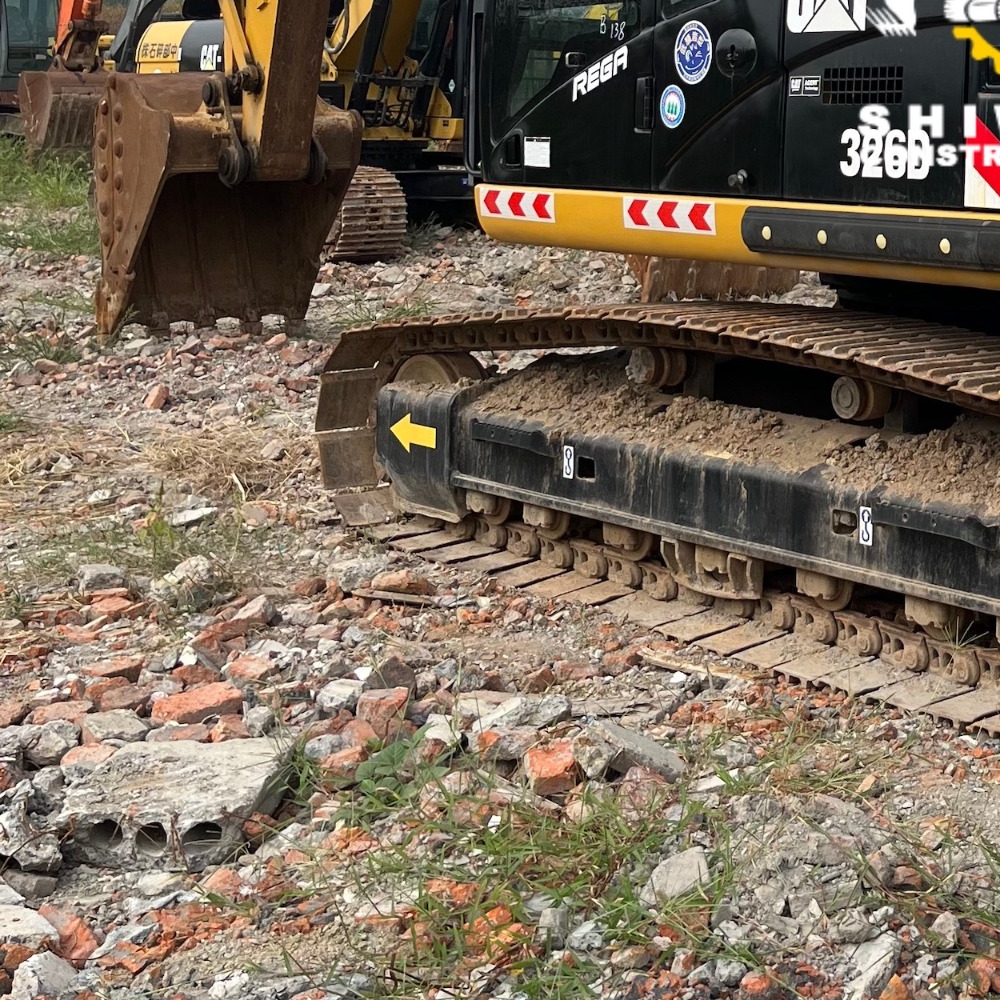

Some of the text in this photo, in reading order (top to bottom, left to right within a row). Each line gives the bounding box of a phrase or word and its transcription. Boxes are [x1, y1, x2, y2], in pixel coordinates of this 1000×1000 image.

[610, 21, 626, 41] 138
[200, 44, 219, 70] CAT
[572, 45, 629, 102] REGA
[840, 129, 931, 180] 326D
